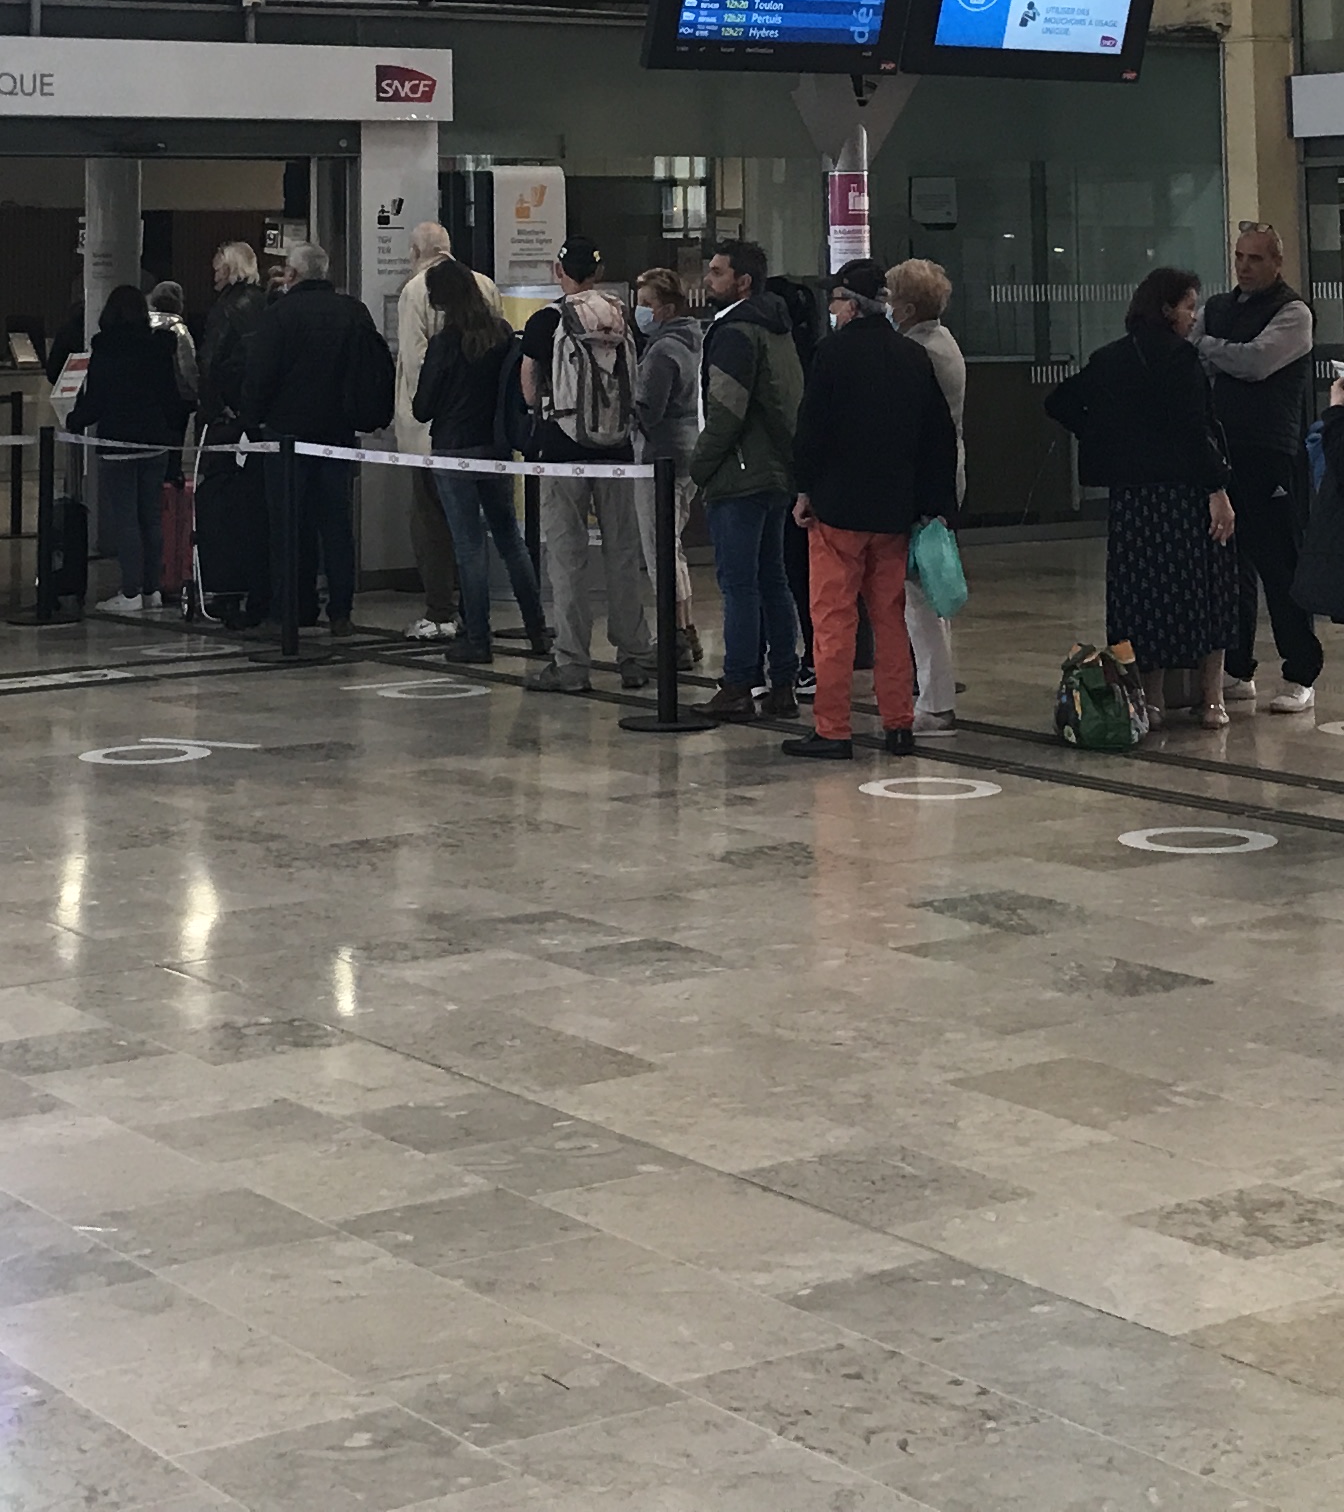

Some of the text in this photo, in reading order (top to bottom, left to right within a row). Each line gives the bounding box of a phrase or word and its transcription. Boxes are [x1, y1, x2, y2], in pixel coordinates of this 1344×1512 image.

[754, 0, 784, 12] Toulon
[751, 13, 783, 25] Pertuis
[748, 26, 780, 39] Hyères
[379, 78, 433, 99] SNCF
